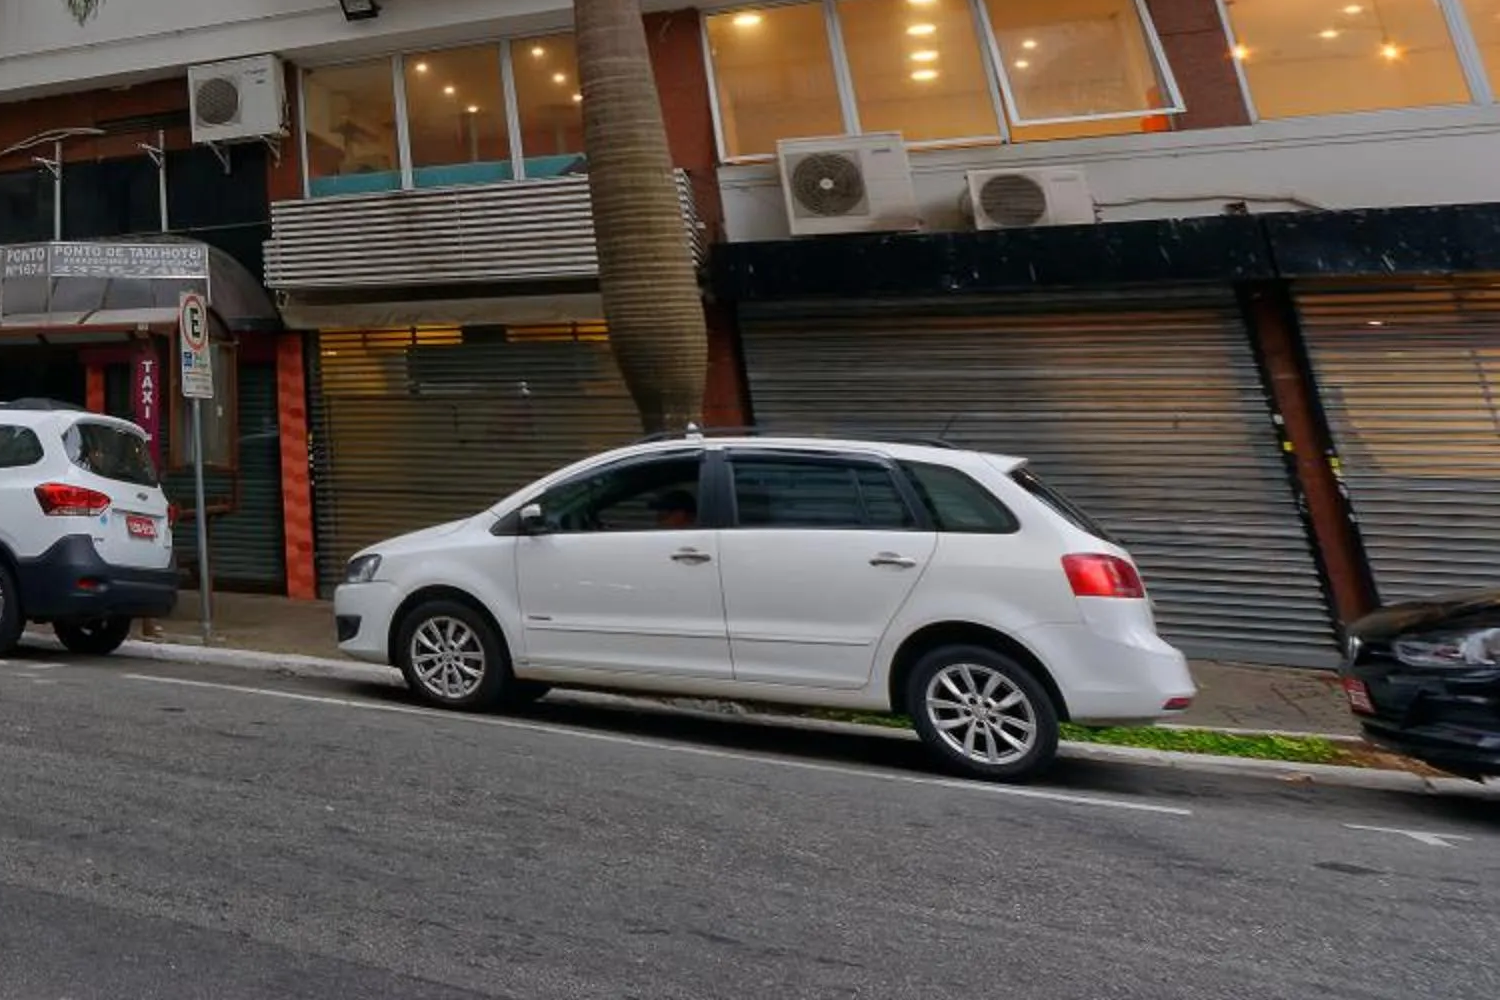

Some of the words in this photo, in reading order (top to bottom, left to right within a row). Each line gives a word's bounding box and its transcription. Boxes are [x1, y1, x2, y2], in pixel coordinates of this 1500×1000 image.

[7, 247, 45, 263] PONTO
[54, 245, 100, 257] PONTO
[106, 247, 125, 257] DE
[129, 247, 158, 259] TAXI
[141, 359, 154, 419] TAXI
